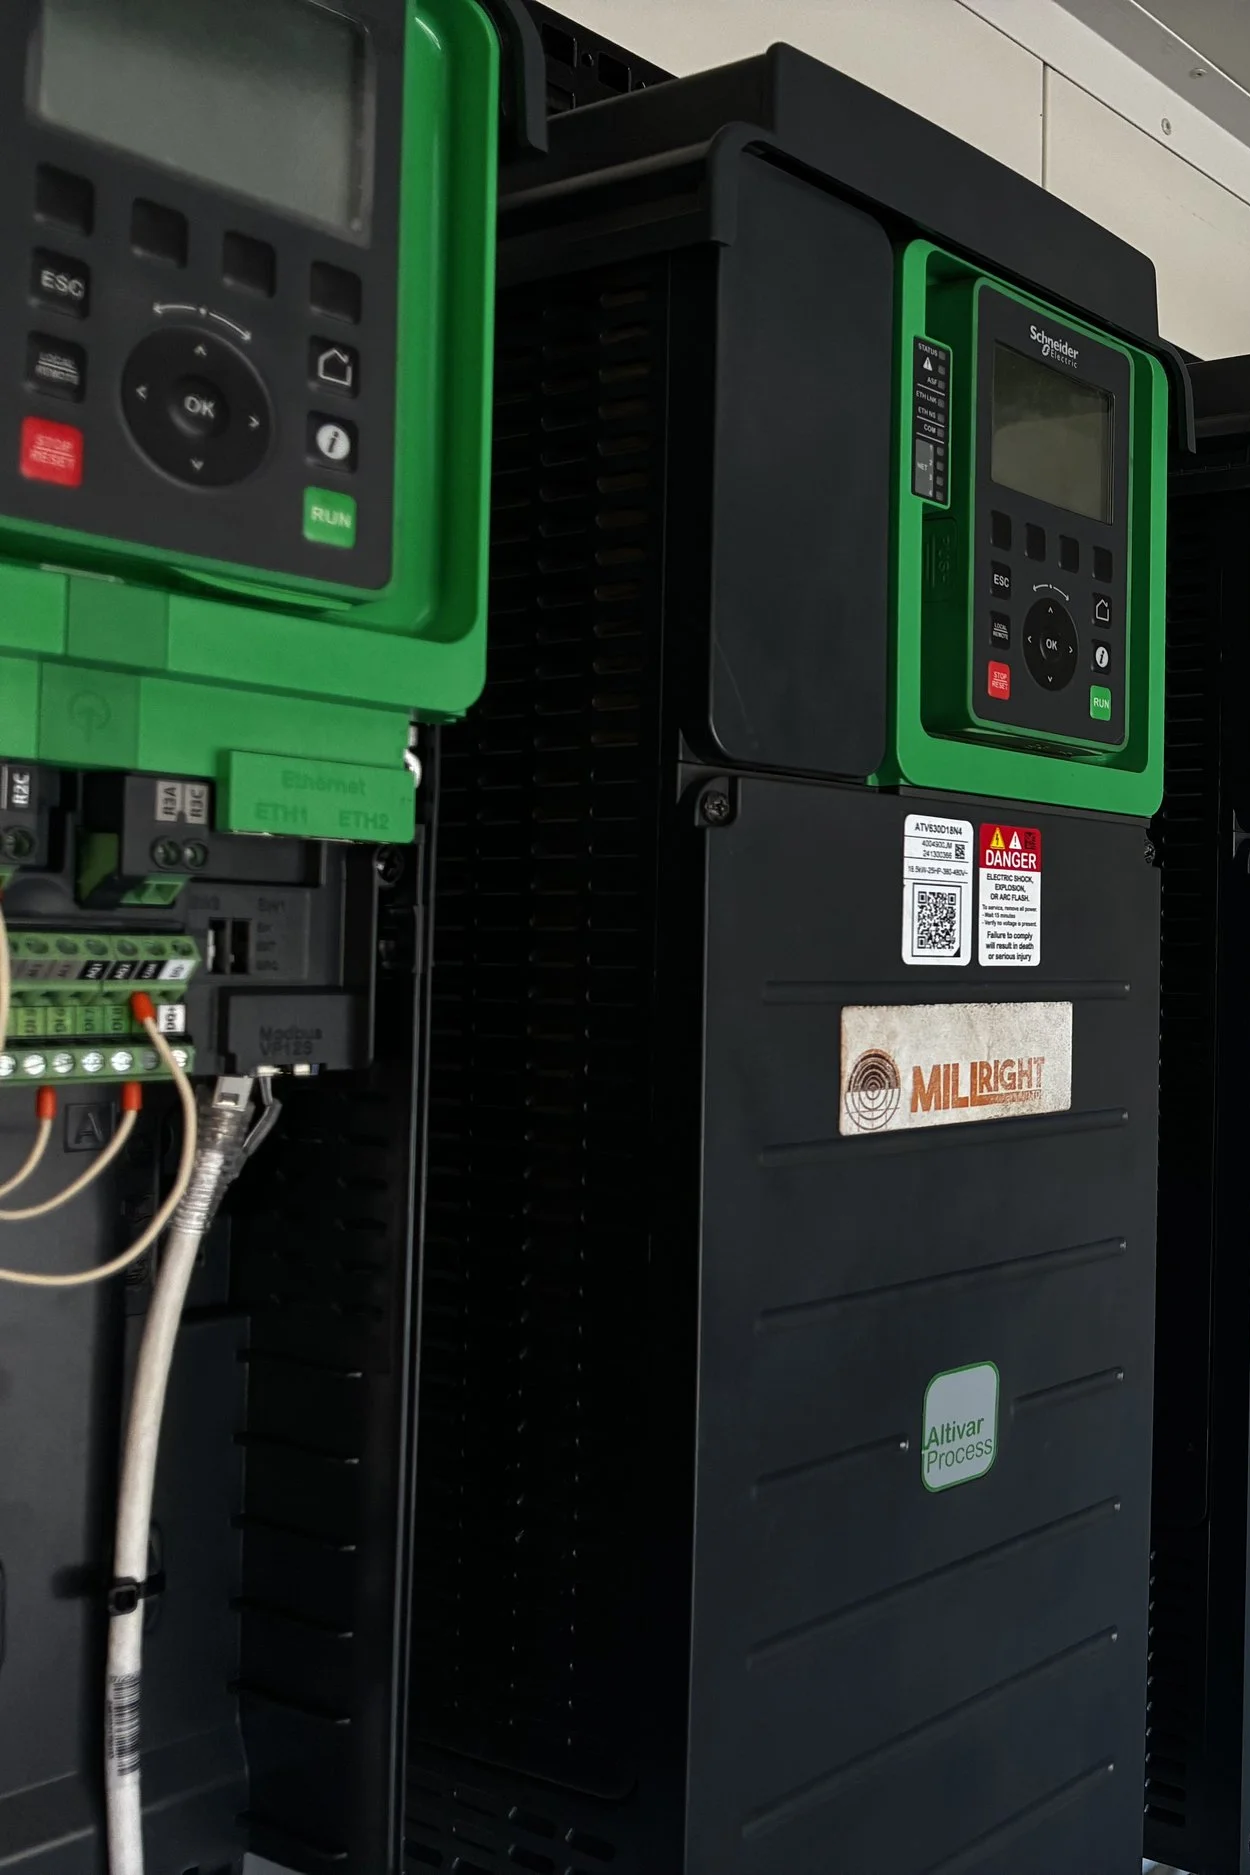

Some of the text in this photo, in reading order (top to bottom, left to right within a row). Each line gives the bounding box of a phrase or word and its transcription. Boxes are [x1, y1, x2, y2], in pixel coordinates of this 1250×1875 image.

[41, 270, 85, 299] ESC
[918, 342, 938, 357] STATUS
[1030, 325, 1079, 359] Schneider
[1050, 349, 1078, 369] Electric
[184, 396, 215, 419] OK
[923, 423, 936, 434] COM
[312, 506, 352, 530] RUN
[993, 573, 1010, 588] ESC
[994, 622, 1007, 631] LOCAL
[1046, 638, 1058, 651] OK
[993, 671, 1008, 680] STOP
[992, 680, 1008, 691] RESET
[1093, 697, 1110, 710] RUN
[282, 770, 366, 796] Ethernet
[255, 802, 389, 830] ETH1 ETH2
[985, 849, 1037, 870] DANGER
[986, 873, 1034, 884] ELECTRIC SHOCK,
[995, 883, 1026, 893] EXPLOSION,
[1011, 894, 1030, 902] FLASH.
[987, 931, 1006, 939] Failure
[1014, 932, 1033, 941] comply
[1019, 942, 1034, 950] death
[995, 952, 1015, 960] serious
[1016, 952, 1032, 962] injury
[259, 1024, 323, 1040] Modbus
[926, 1417, 985, 1450] Altivar
[926, 1438, 993, 1473] Process
